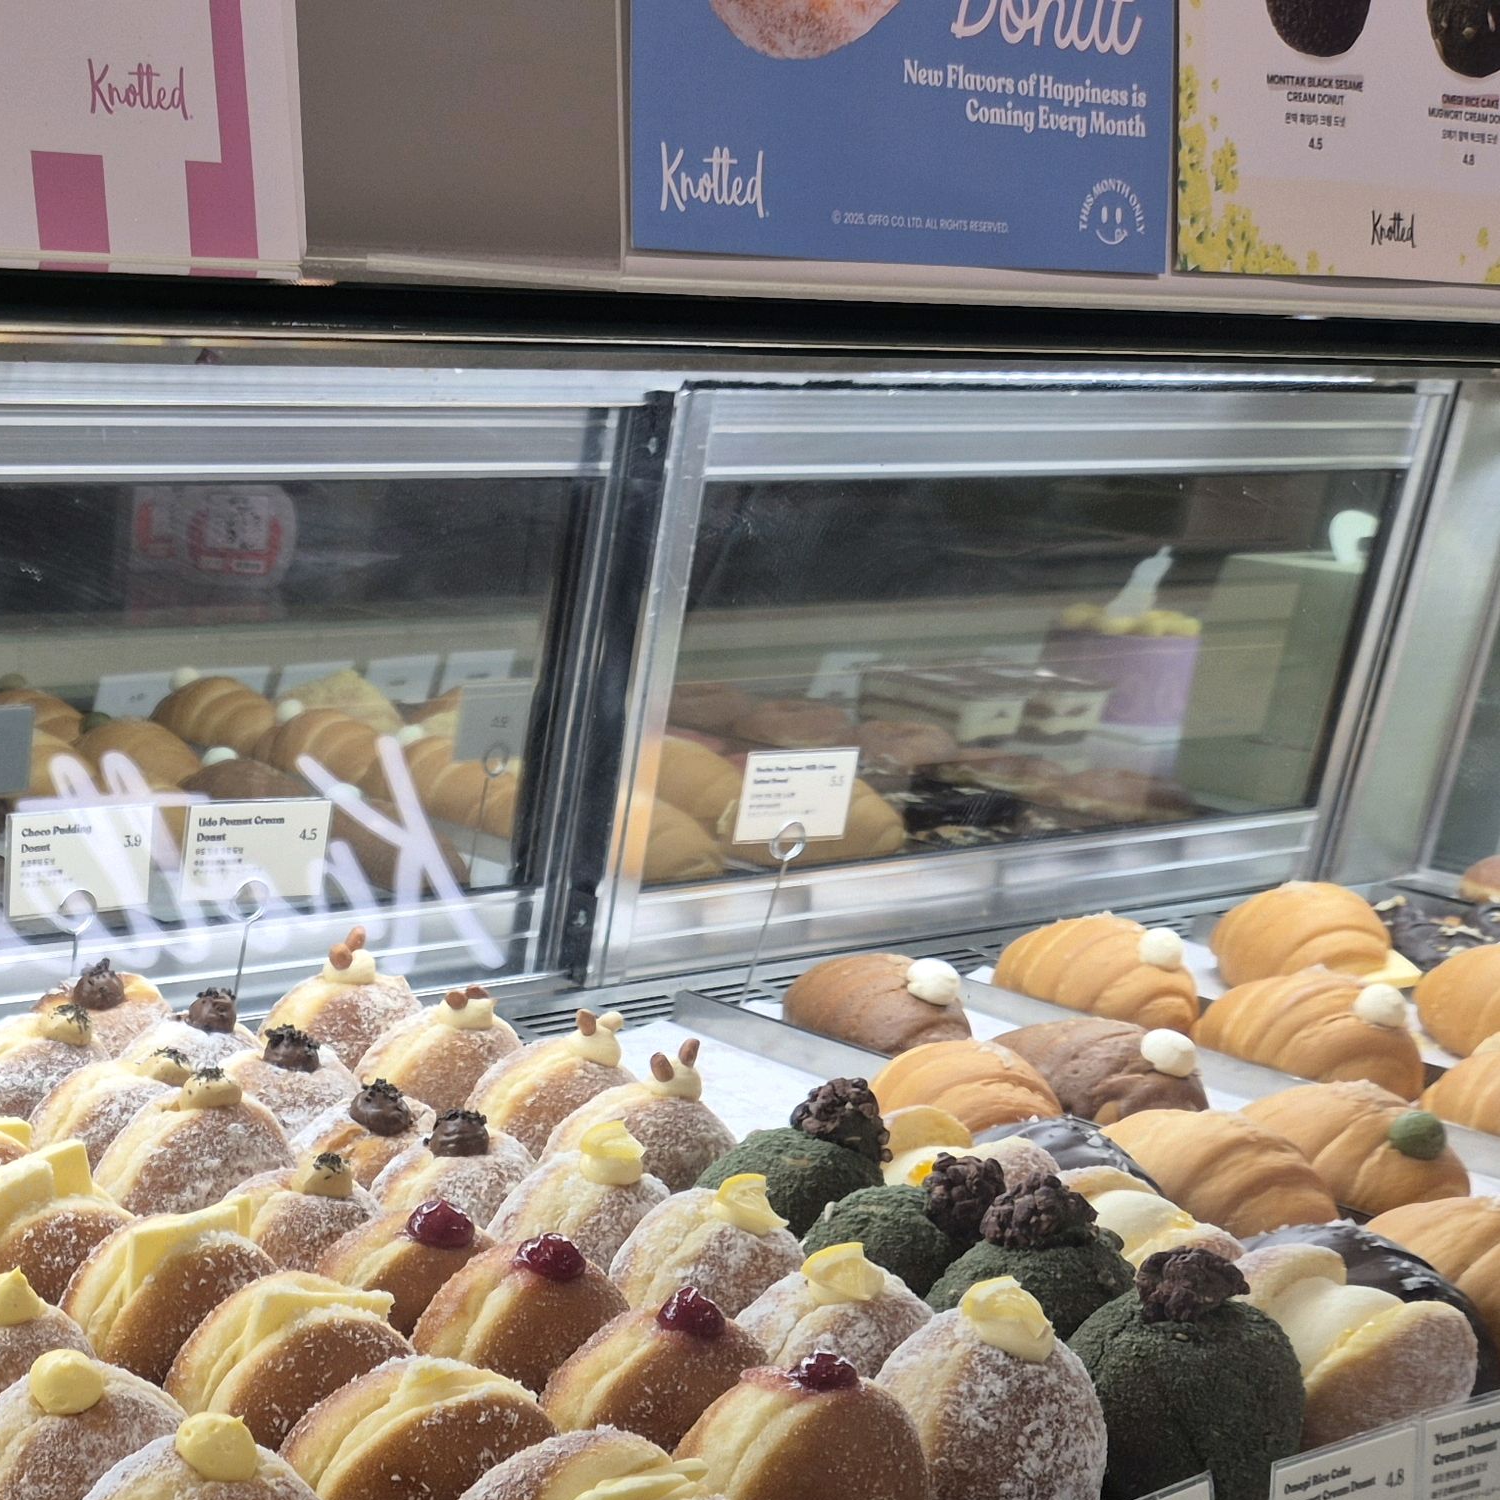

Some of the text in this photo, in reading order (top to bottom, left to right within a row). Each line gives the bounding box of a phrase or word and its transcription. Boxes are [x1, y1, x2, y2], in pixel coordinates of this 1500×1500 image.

[87, 58, 190, 121] Knotted
[903, 59, 1147, 109] New Flavors of Happiness is
[1307, 77, 1334, 89] BLACK
[1334, 79, 1364, 92] SESAME
[1286, 91, 1345, 106] CREAM DONUT
[965, 98, 1146, 138] Coming Every Month
[1308, 137, 1323, 150] 4.5
[660, 141, 765, 219] Knotted
[1079, 178, 1145, 235] THIS MONTH ONLY
[925, 218, 938, 230] ALL
[940, 219, 968, 232] RIGHTS
[1371, 209, 1416, 248] Knotted
[21, 827, 51, 838] Choco
[196, 832, 227, 843] Donut
[299, 828, 318, 841] 4.5
[21, 843, 51, 854] Donut
[123, 834, 142, 848] 3.9
